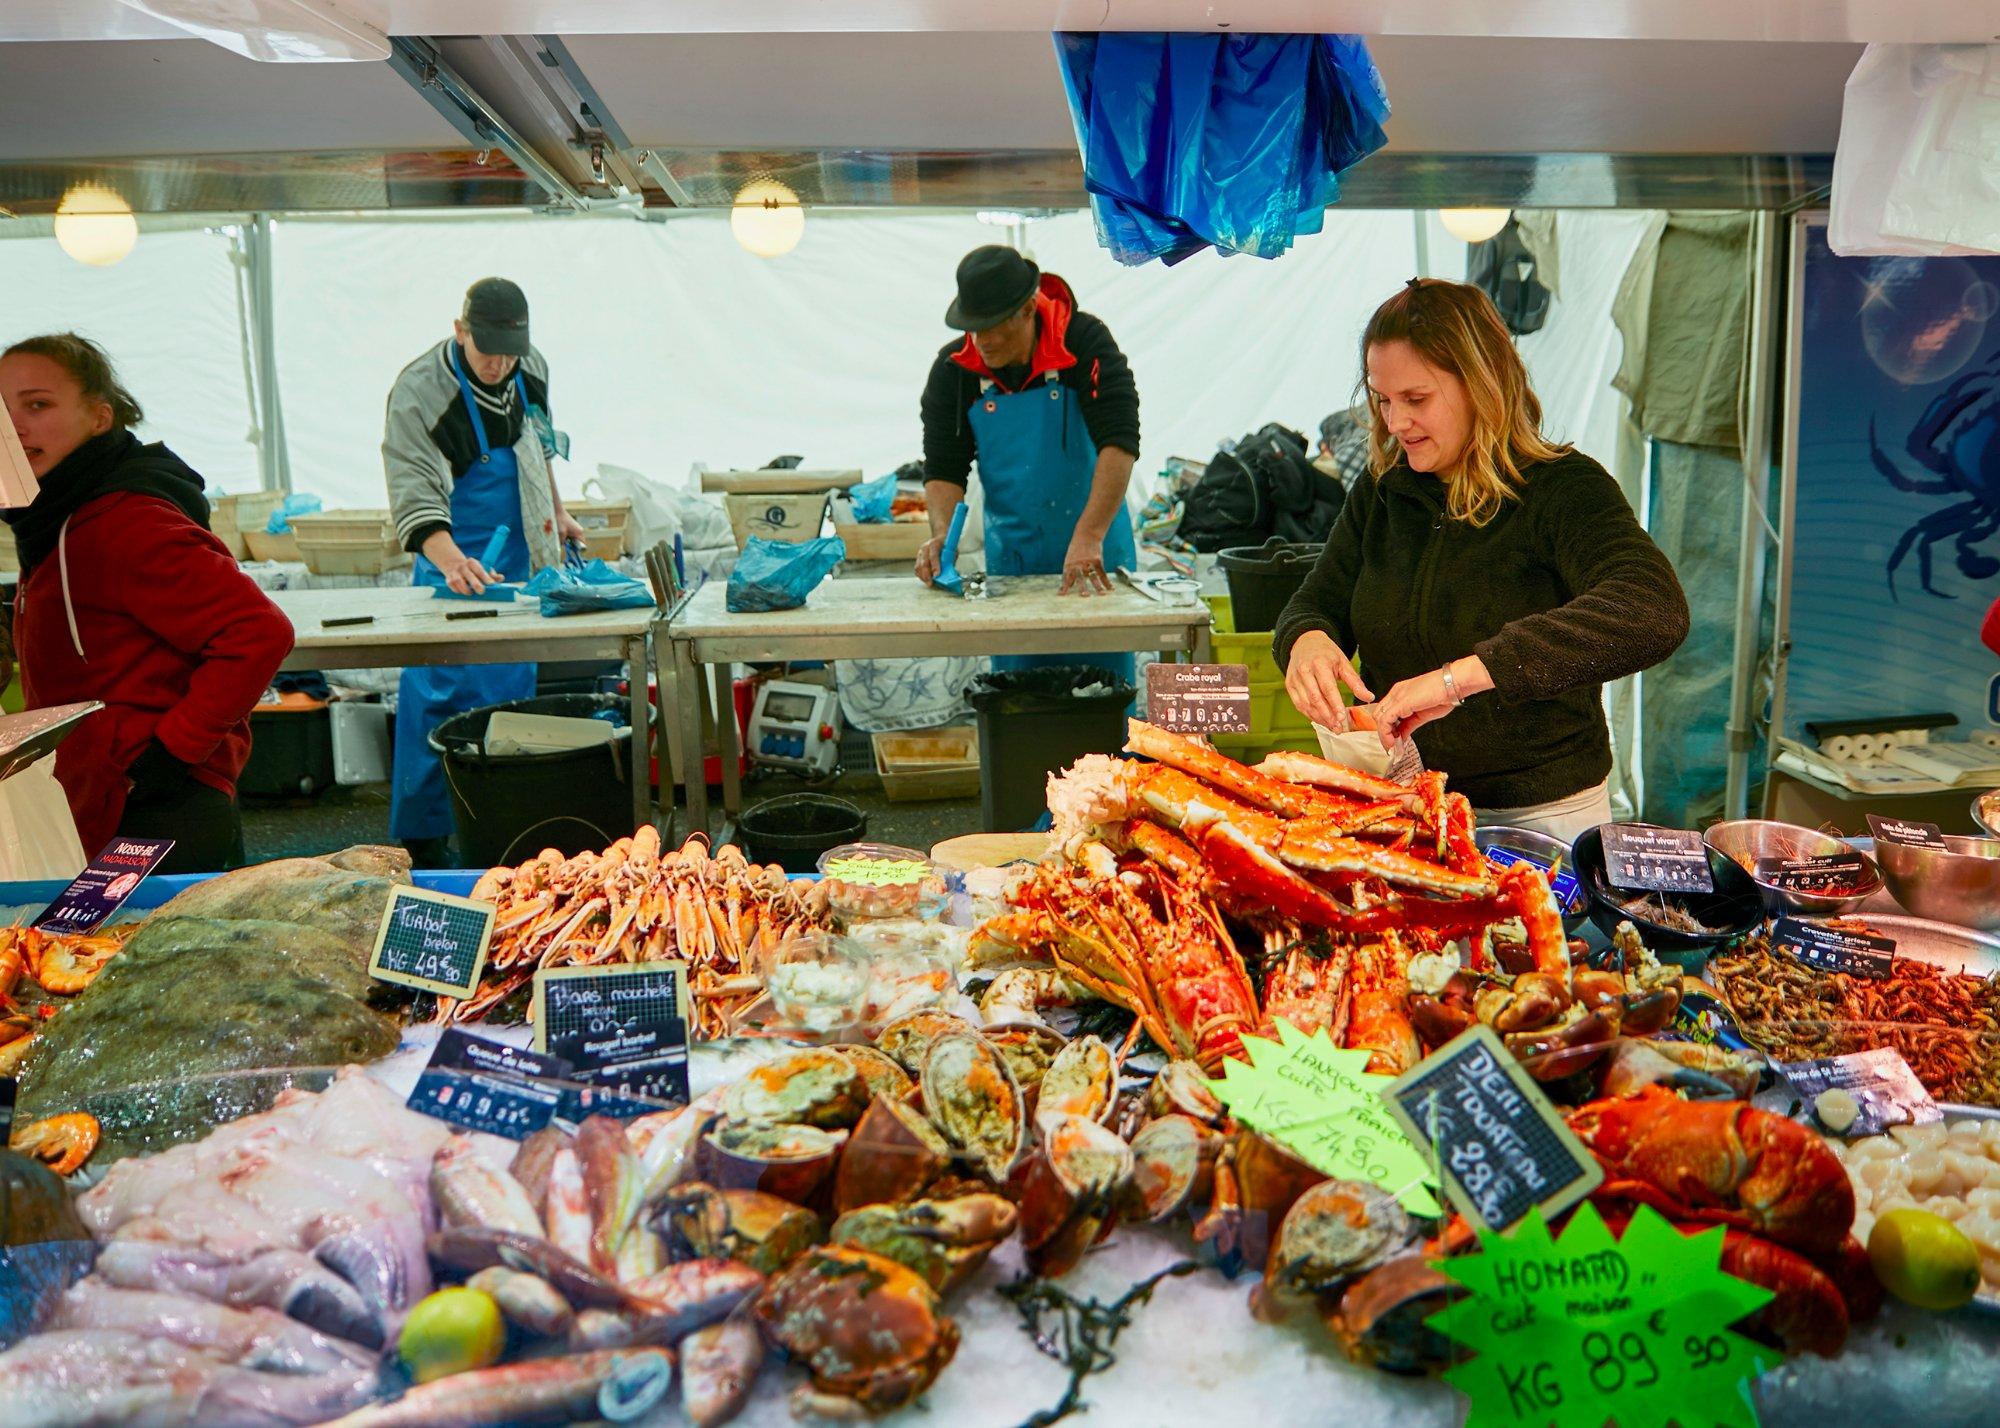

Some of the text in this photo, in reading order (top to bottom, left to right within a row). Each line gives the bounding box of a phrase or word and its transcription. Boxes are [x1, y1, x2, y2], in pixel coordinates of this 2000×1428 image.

[1175, 672, 1221, 684] Crabe royal
[1621, 833, 1681, 846] Bouquet vivant
[100, 855, 153, 867] MADAGASCAR
[1782, 859, 1816, 867] Bouquet
[424, 931, 458, 951] breton
[1801, 926, 1843, 940] Crevettes
[1844, 935, 1871, 946] grises
[387, 948, 408, 971] KG
[1492, 1249, 1630, 1297] HOMARD
[1564, 1295, 1634, 1319] maison
[1496, 1360, 1565, 1420] KG
